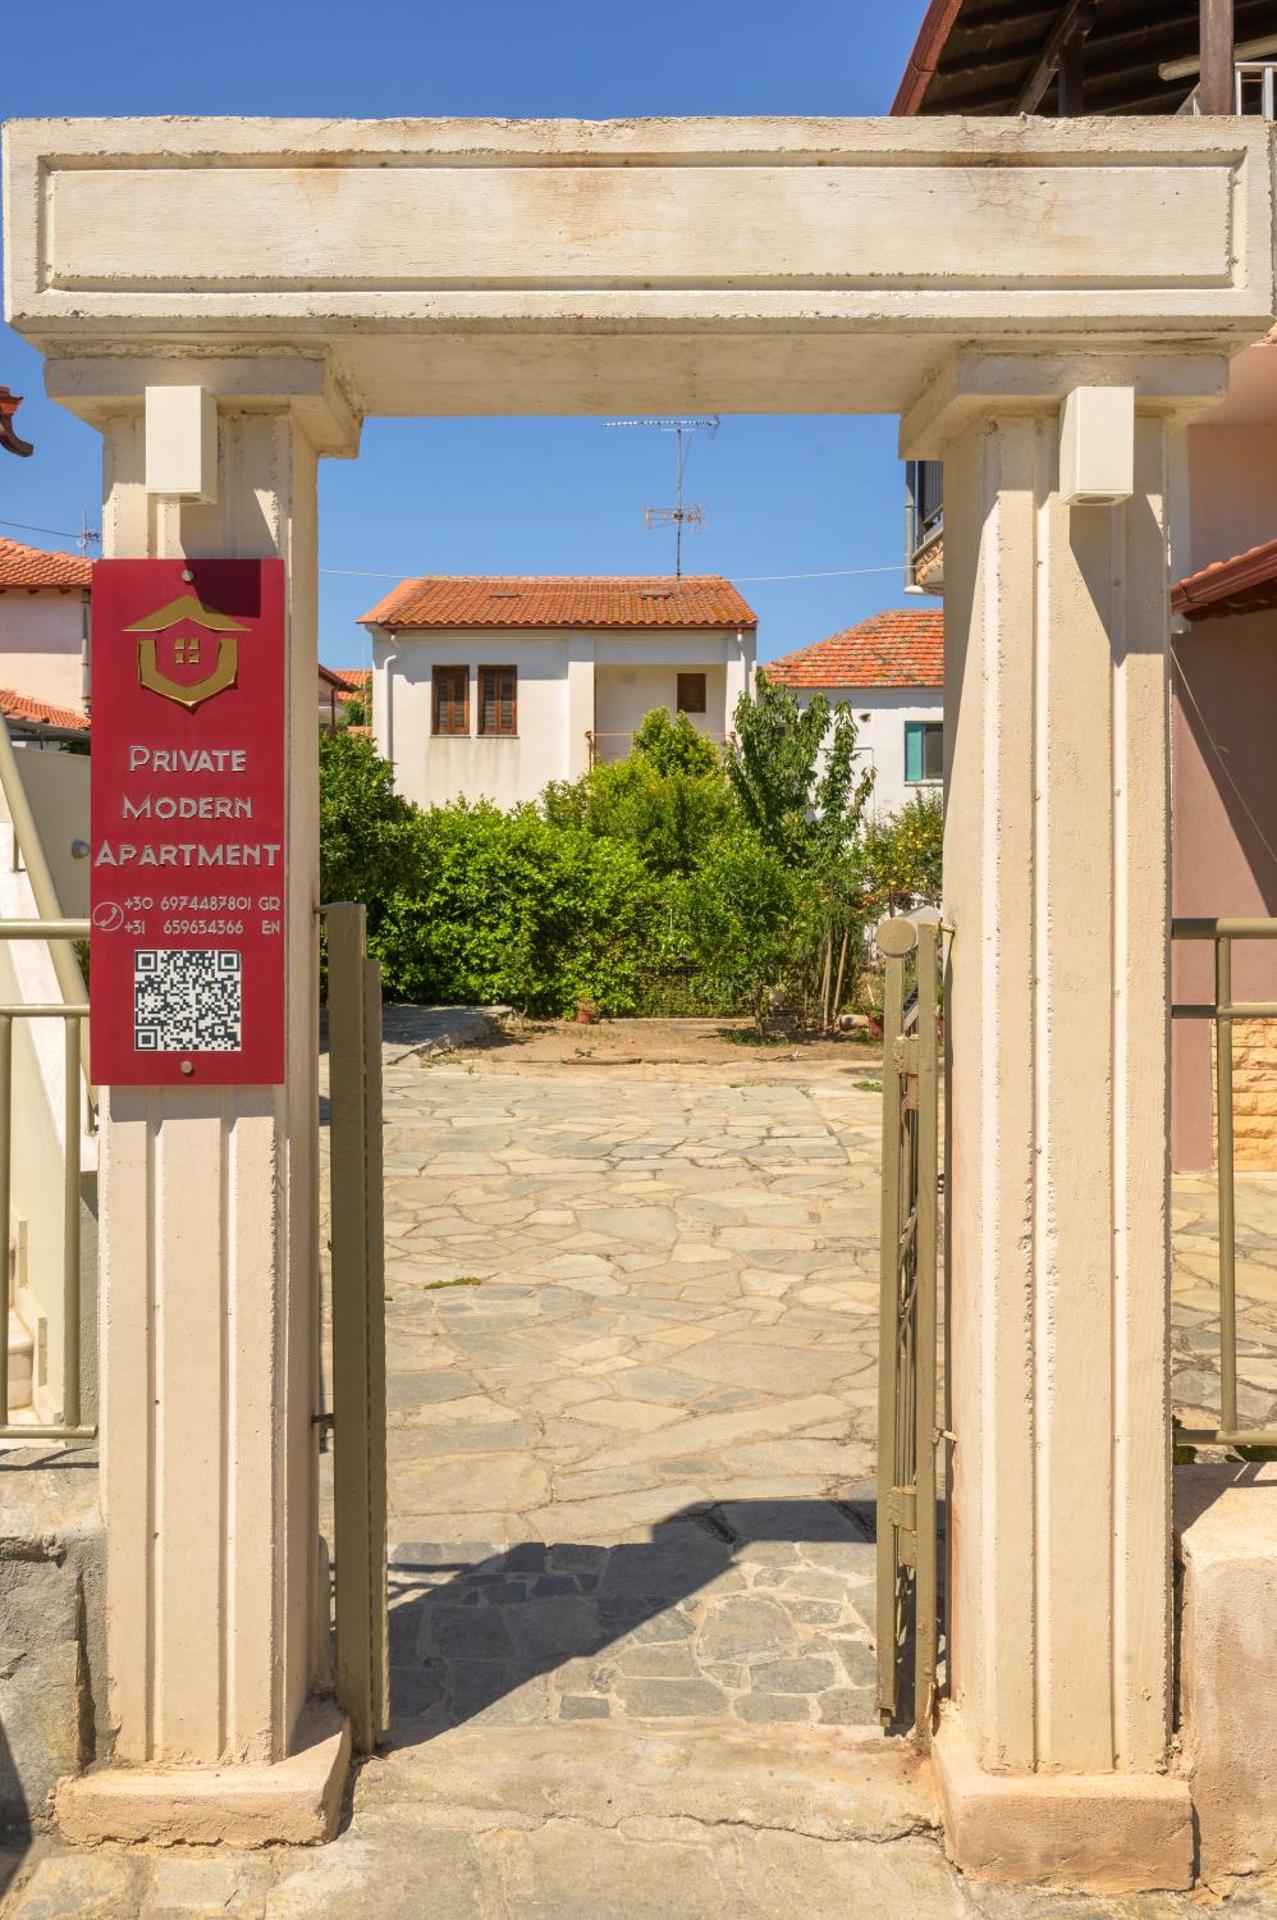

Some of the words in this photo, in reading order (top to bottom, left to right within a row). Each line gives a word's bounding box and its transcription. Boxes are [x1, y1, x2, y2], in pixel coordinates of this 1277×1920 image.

[129, 745, 247, 773] PRIVATE
[121, 793, 253, 820] MODERN
[95, 840, 281, 867] APARTMENT
[124, 896, 153, 911] +30
[160, 896, 251, 911] 6974487801
[124, 919, 145, 935] +31
[261, 920, 280, 935] EN
